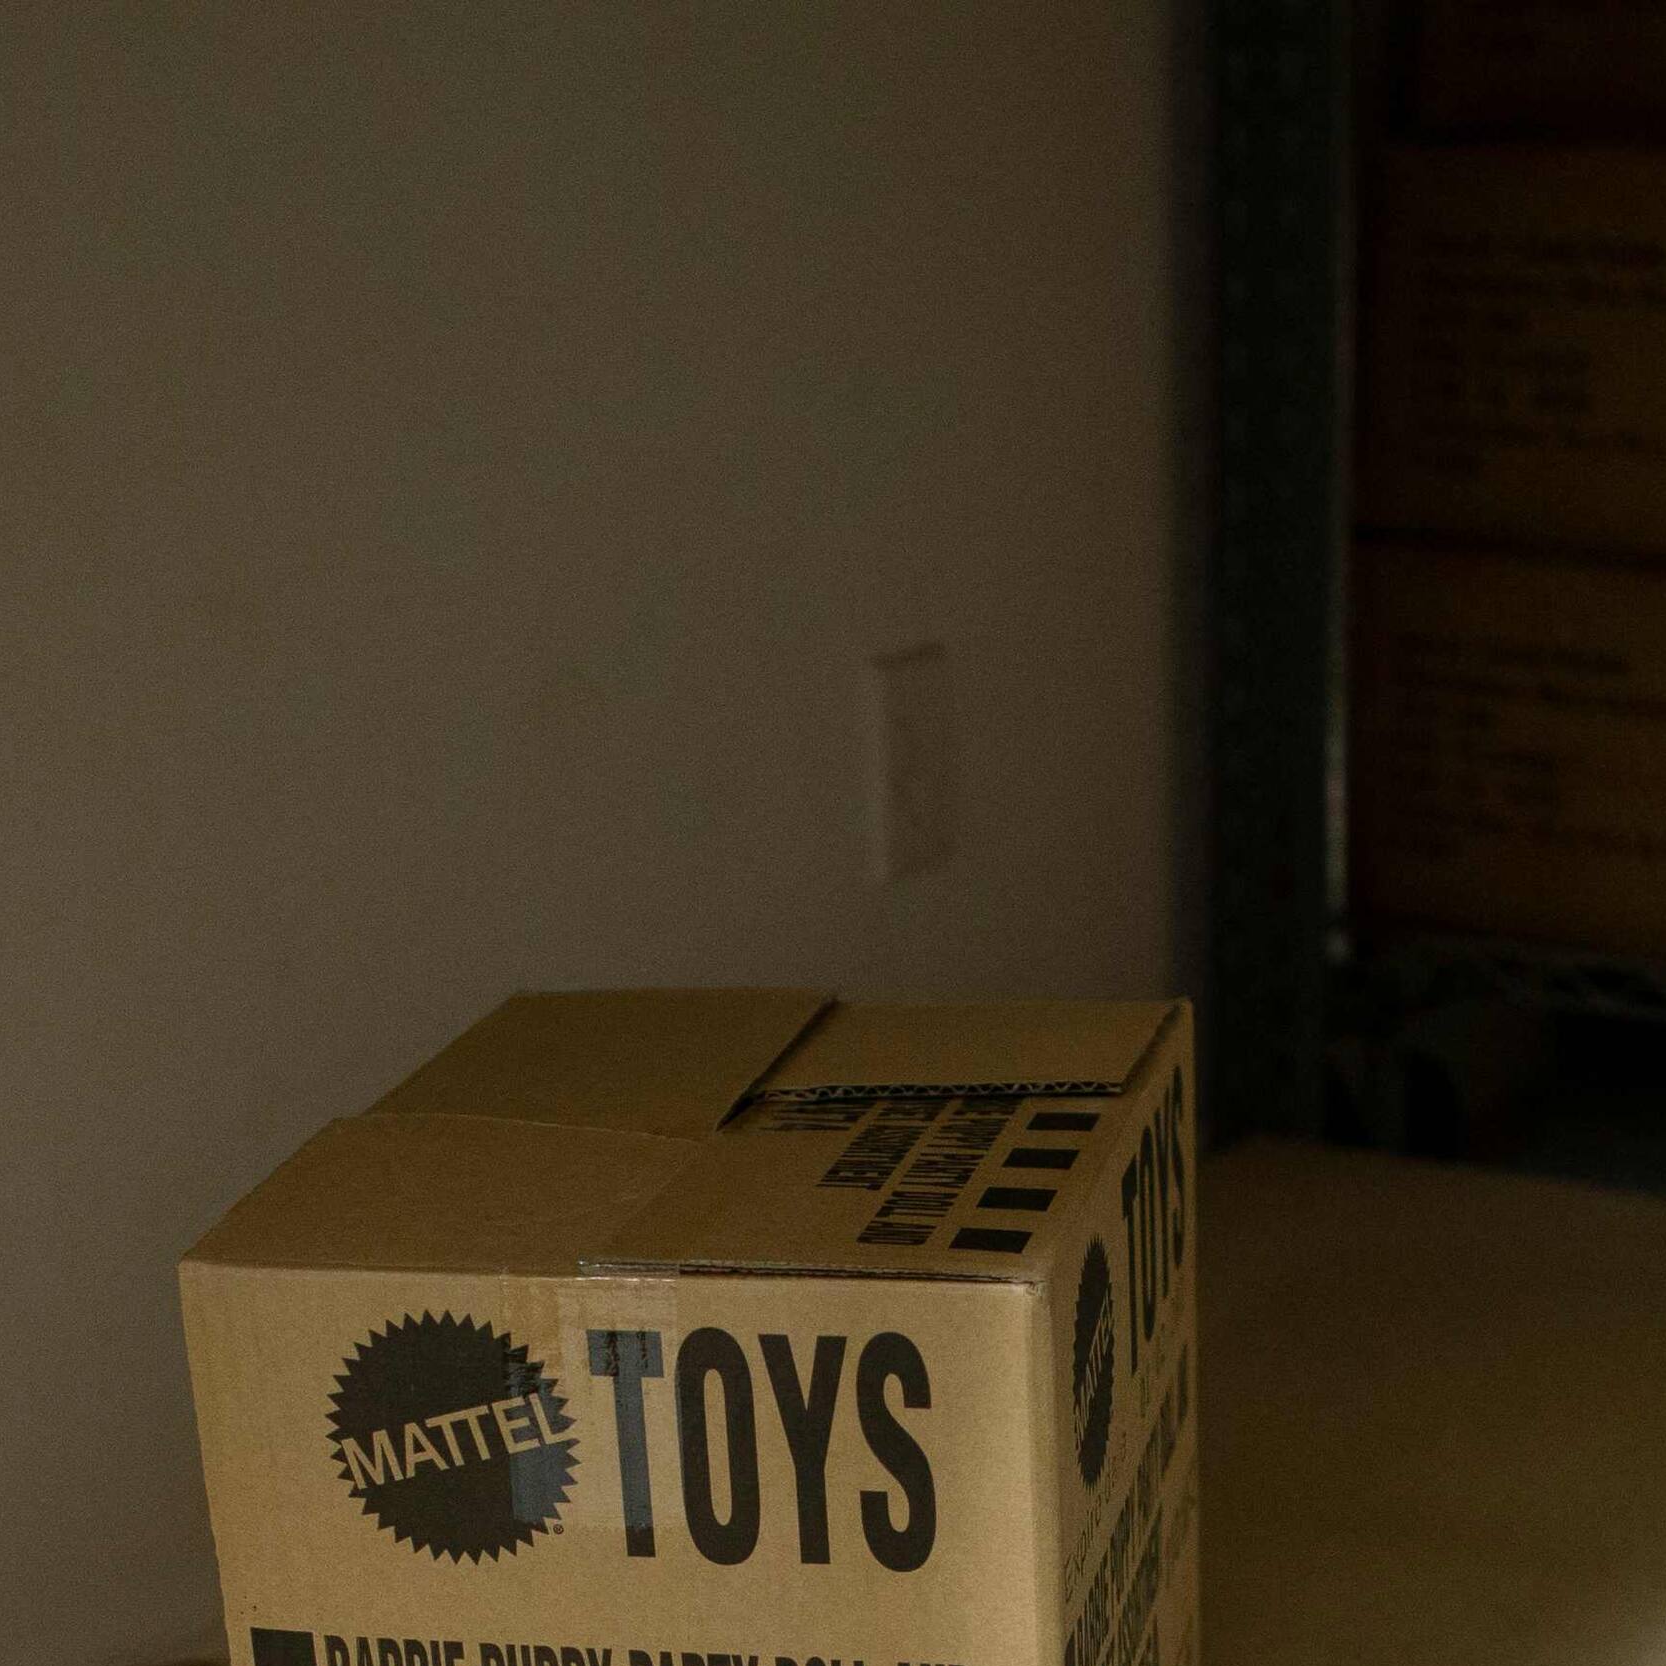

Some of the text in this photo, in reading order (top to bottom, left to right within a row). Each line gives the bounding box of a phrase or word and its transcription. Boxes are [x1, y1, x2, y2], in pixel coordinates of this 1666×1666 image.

[1121, 1064, 1184, 1376] TOYS
[341, 1392, 568, 1491] MATTEL
[586, 1327, 934, 1572] TOYS
